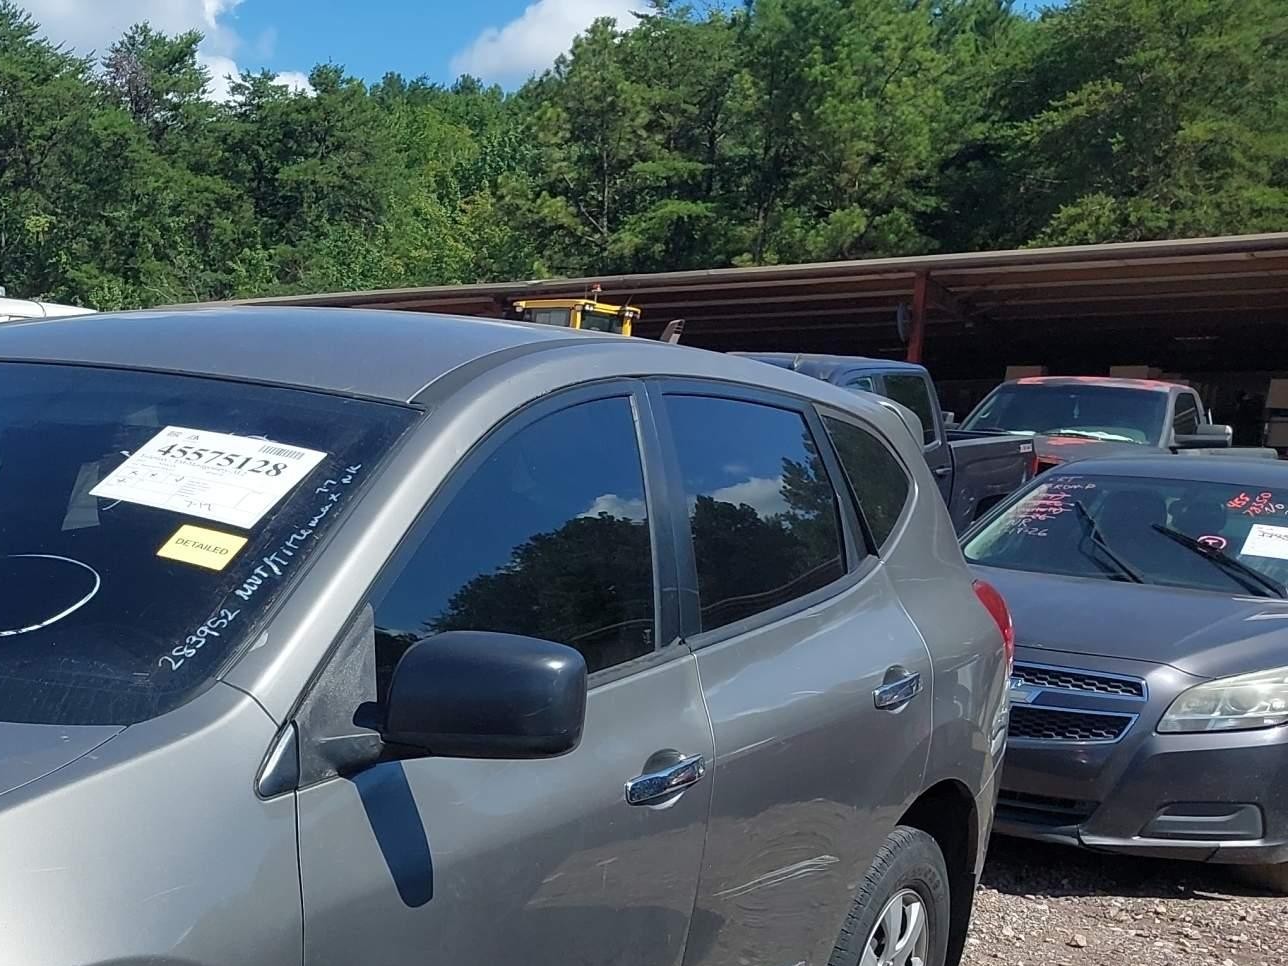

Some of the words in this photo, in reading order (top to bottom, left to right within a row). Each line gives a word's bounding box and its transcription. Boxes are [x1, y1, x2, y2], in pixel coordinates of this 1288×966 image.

[158, 443, 288, 477] 45575128
[175, 537, 230, 556] DETAILED
[158, 609, 241, 671] 283952
